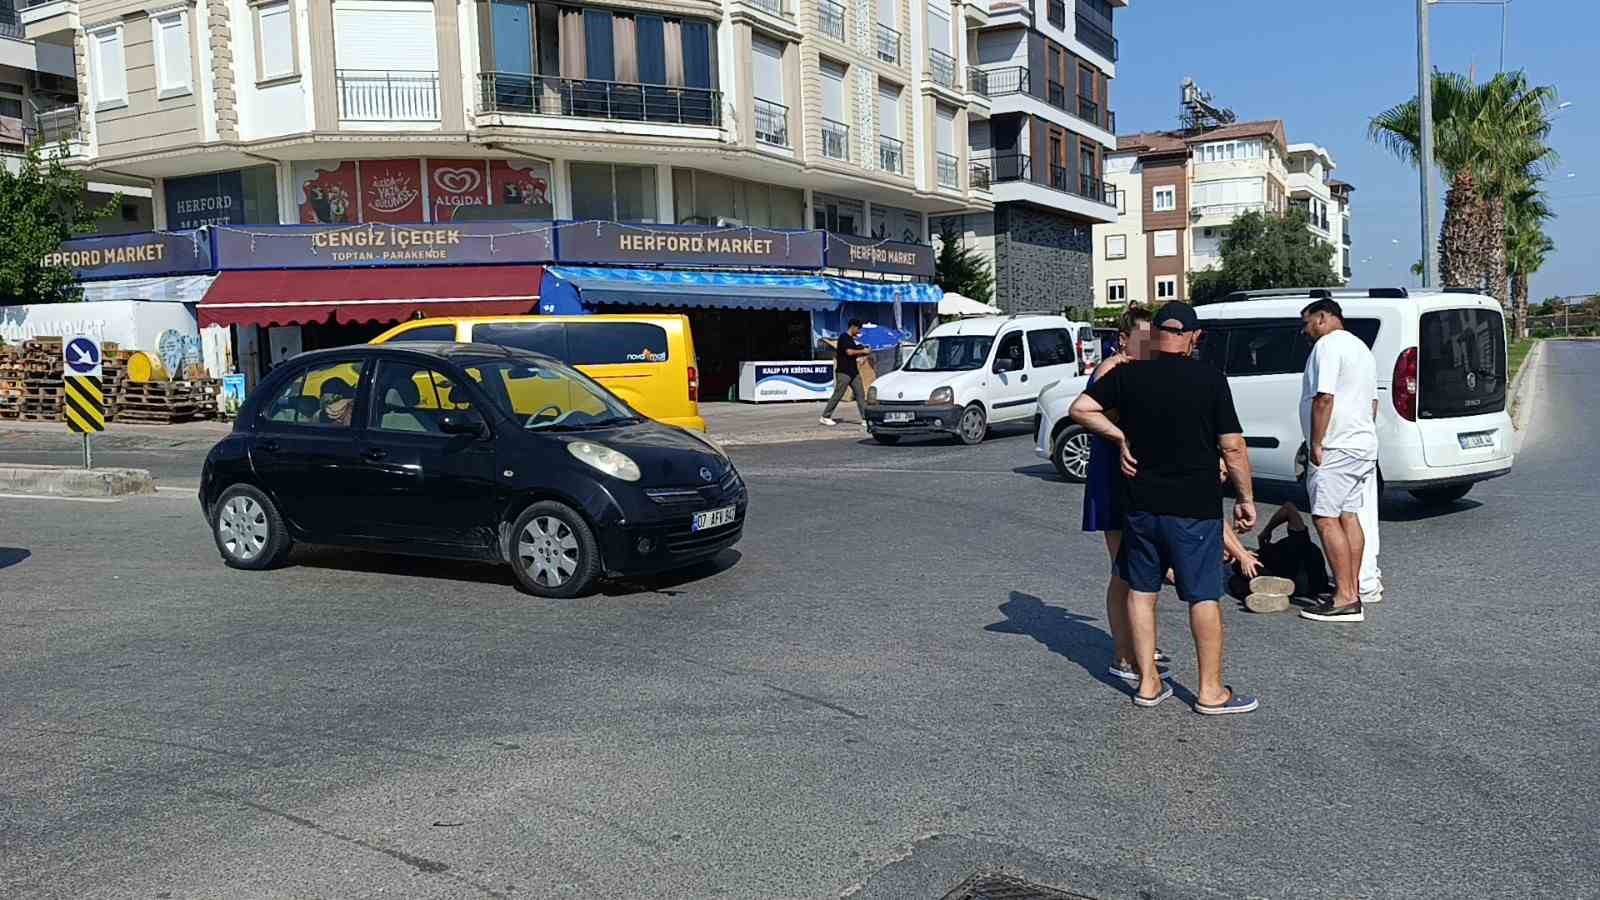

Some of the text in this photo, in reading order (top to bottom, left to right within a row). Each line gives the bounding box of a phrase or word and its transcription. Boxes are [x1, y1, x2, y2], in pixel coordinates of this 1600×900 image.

[176, 195, 232, 214] HERFORD
[315, 228, 460, 249] CENGİZ İÇECEK
[619, 234, 773, 254] HERFORD MARKET
[104, 243, 165, 265] MARKET
[332, 251, 374, 262] TOPTAN
[383, 250, 447, 260] PARAKENDE
[850, 246, 917, 265] HERFORD MARKET
[697, 513, 707, 528] 07
